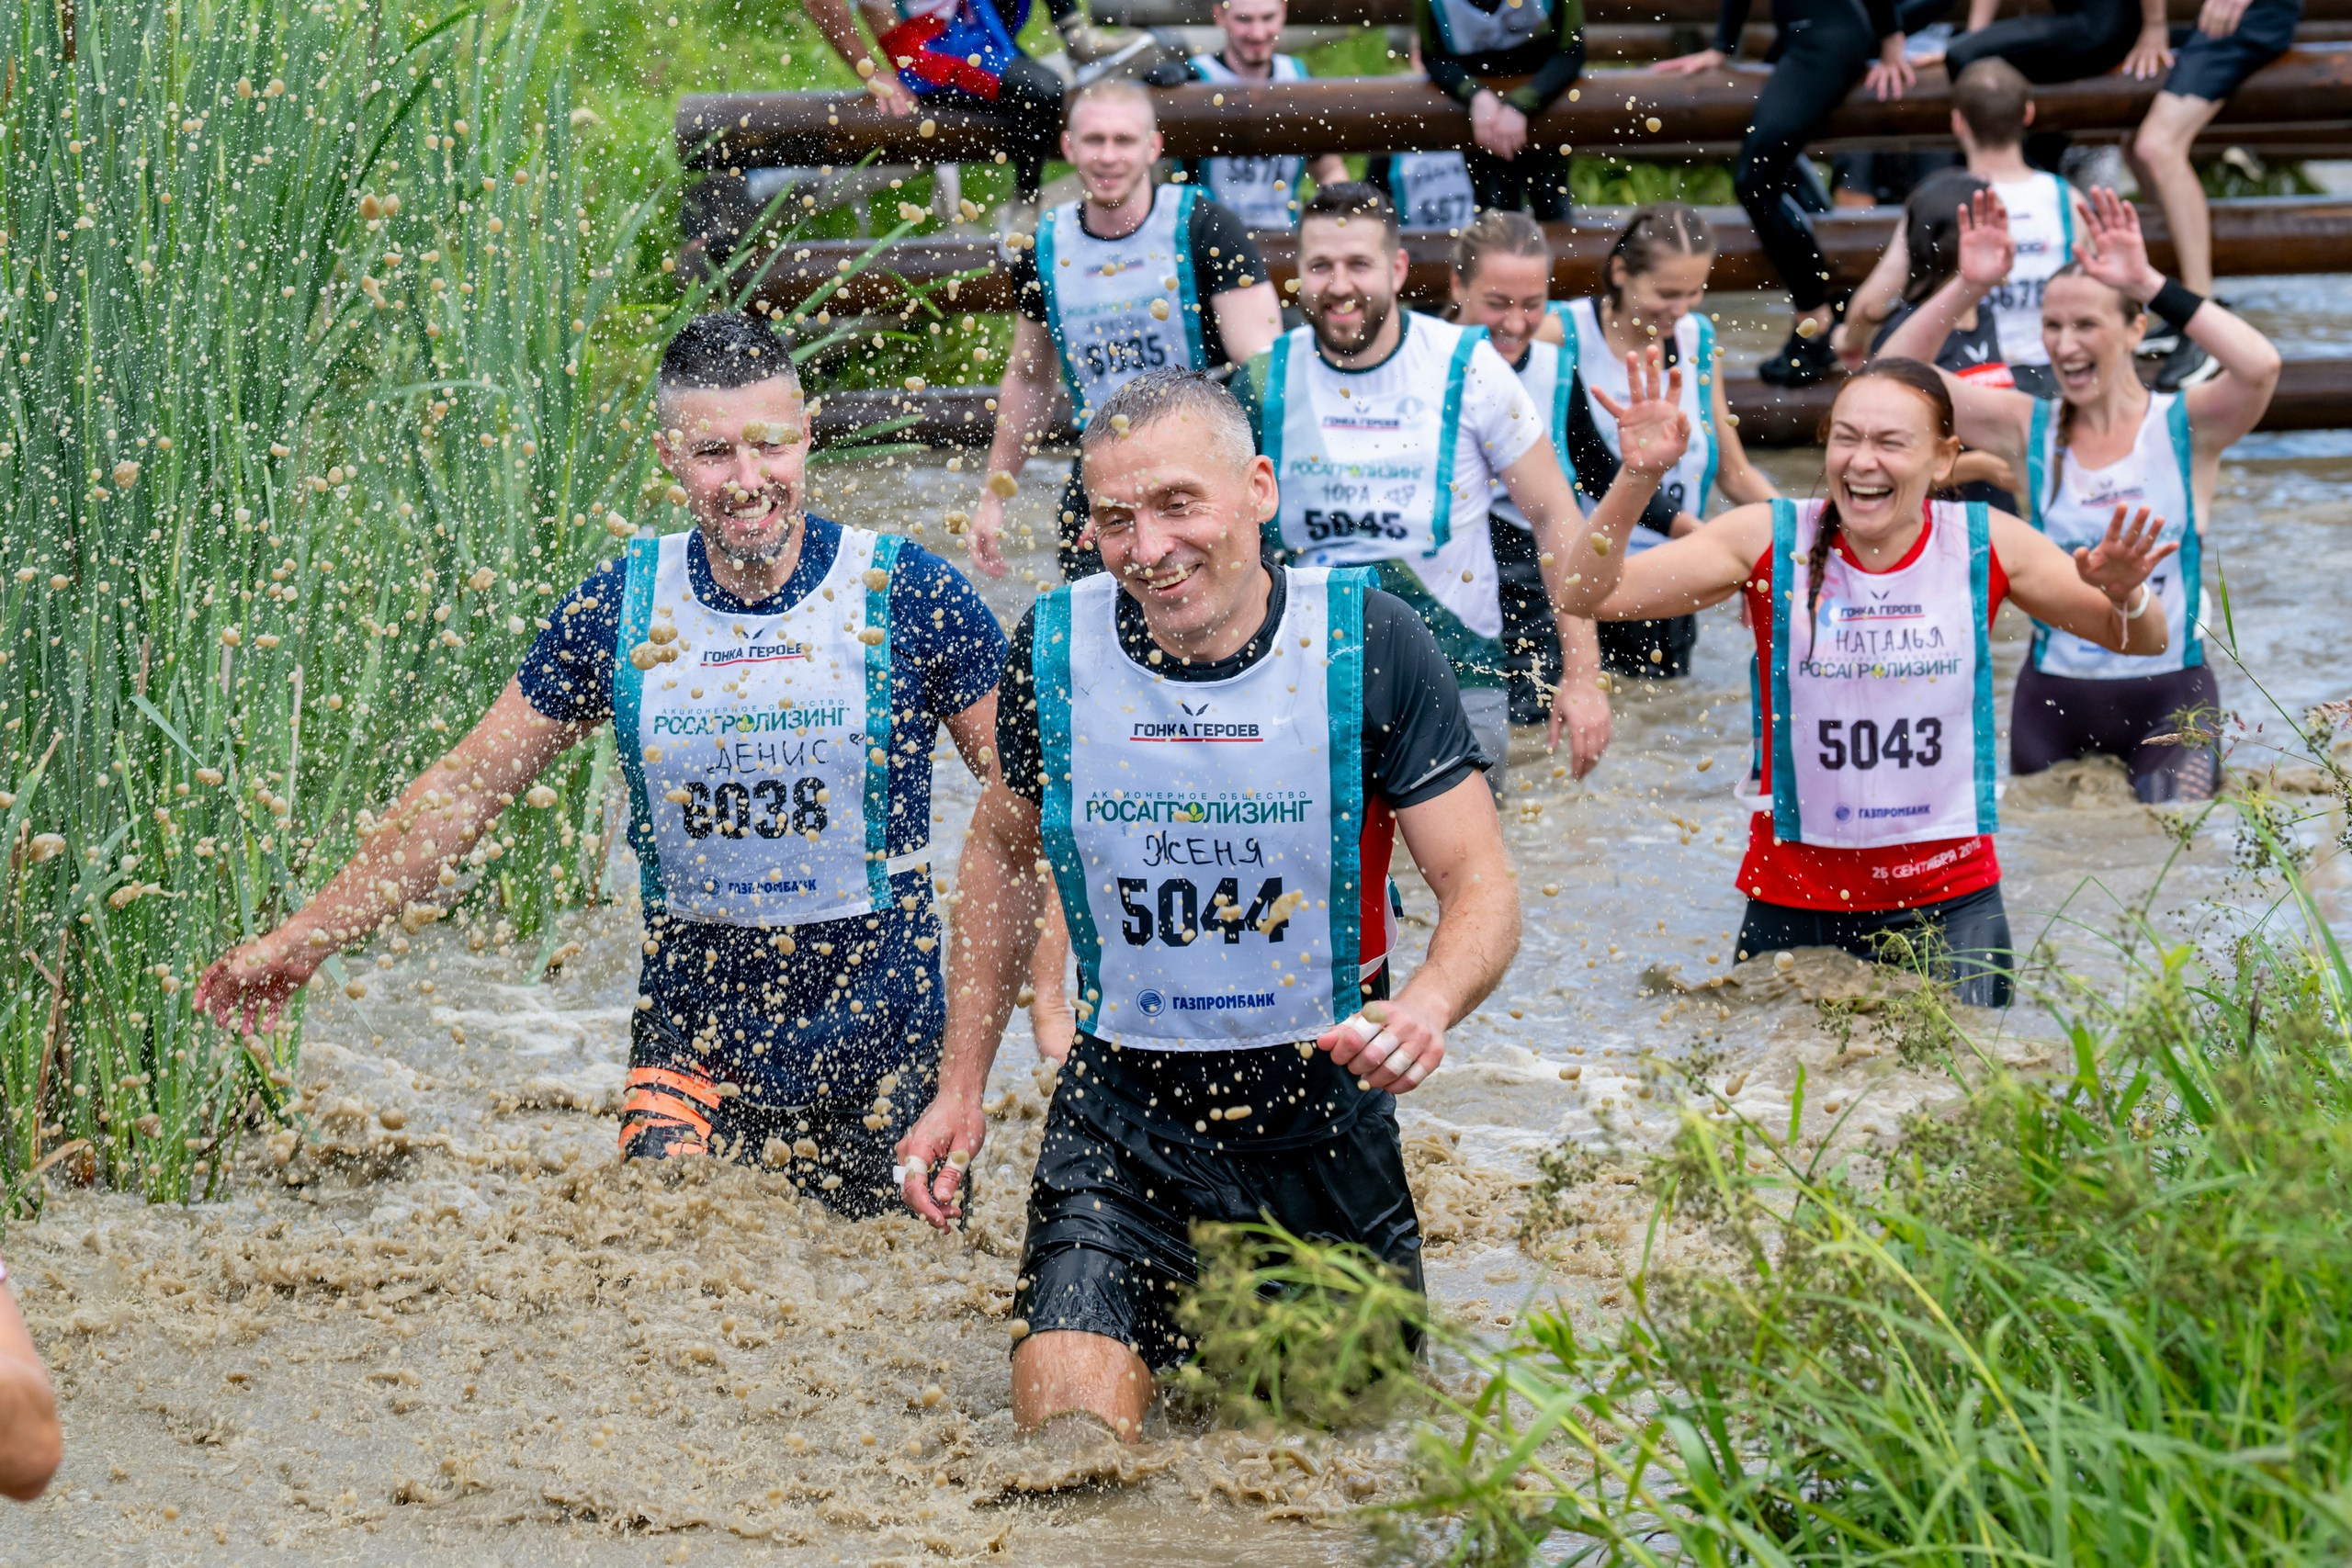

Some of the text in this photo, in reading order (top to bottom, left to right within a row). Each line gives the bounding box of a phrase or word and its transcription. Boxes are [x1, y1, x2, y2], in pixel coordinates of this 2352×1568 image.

[1305, 510, 1408, 541] 5045
[1840, 604, 1922, 617] ГОНКА ГЕРОЕВ
[1836, 626, 1944, 655] НАТАЛЬЯ
[704, 647, 743, 662] ГОНКА
[1799, 658, 1962, 679] РОСАГРОЛИЗИНГ
[768, 699, 844, 711] ОЕСТВО
[654, 706, 850, 735] РОСАГРОЛИЗИНГ
[1134, 723, 1260, 737] ГОНКА ГЕРОЕВ
[1818, 717, 1942, 771] 5043
[707, 739, 830, 775] ДЕНИС
[1092, 791, 1206, 800] АКИОНЕРНОЕ
[683, 777, 828, 840] 6038
[1086, 799, 1312, 824] РОСАГРОЛИЗИНГ
[1858, 804, 1931, 819] ГАЗПРОМБАНК
[1143, 830, 1264, 868] ЖЕНЯ
[729, 879, 817, 895] ГАЗПОМБАК
[1117, 877, 1289, 947] 5044
[1172, 992, 1275, 1010] ГАЗПРОМБАНК
